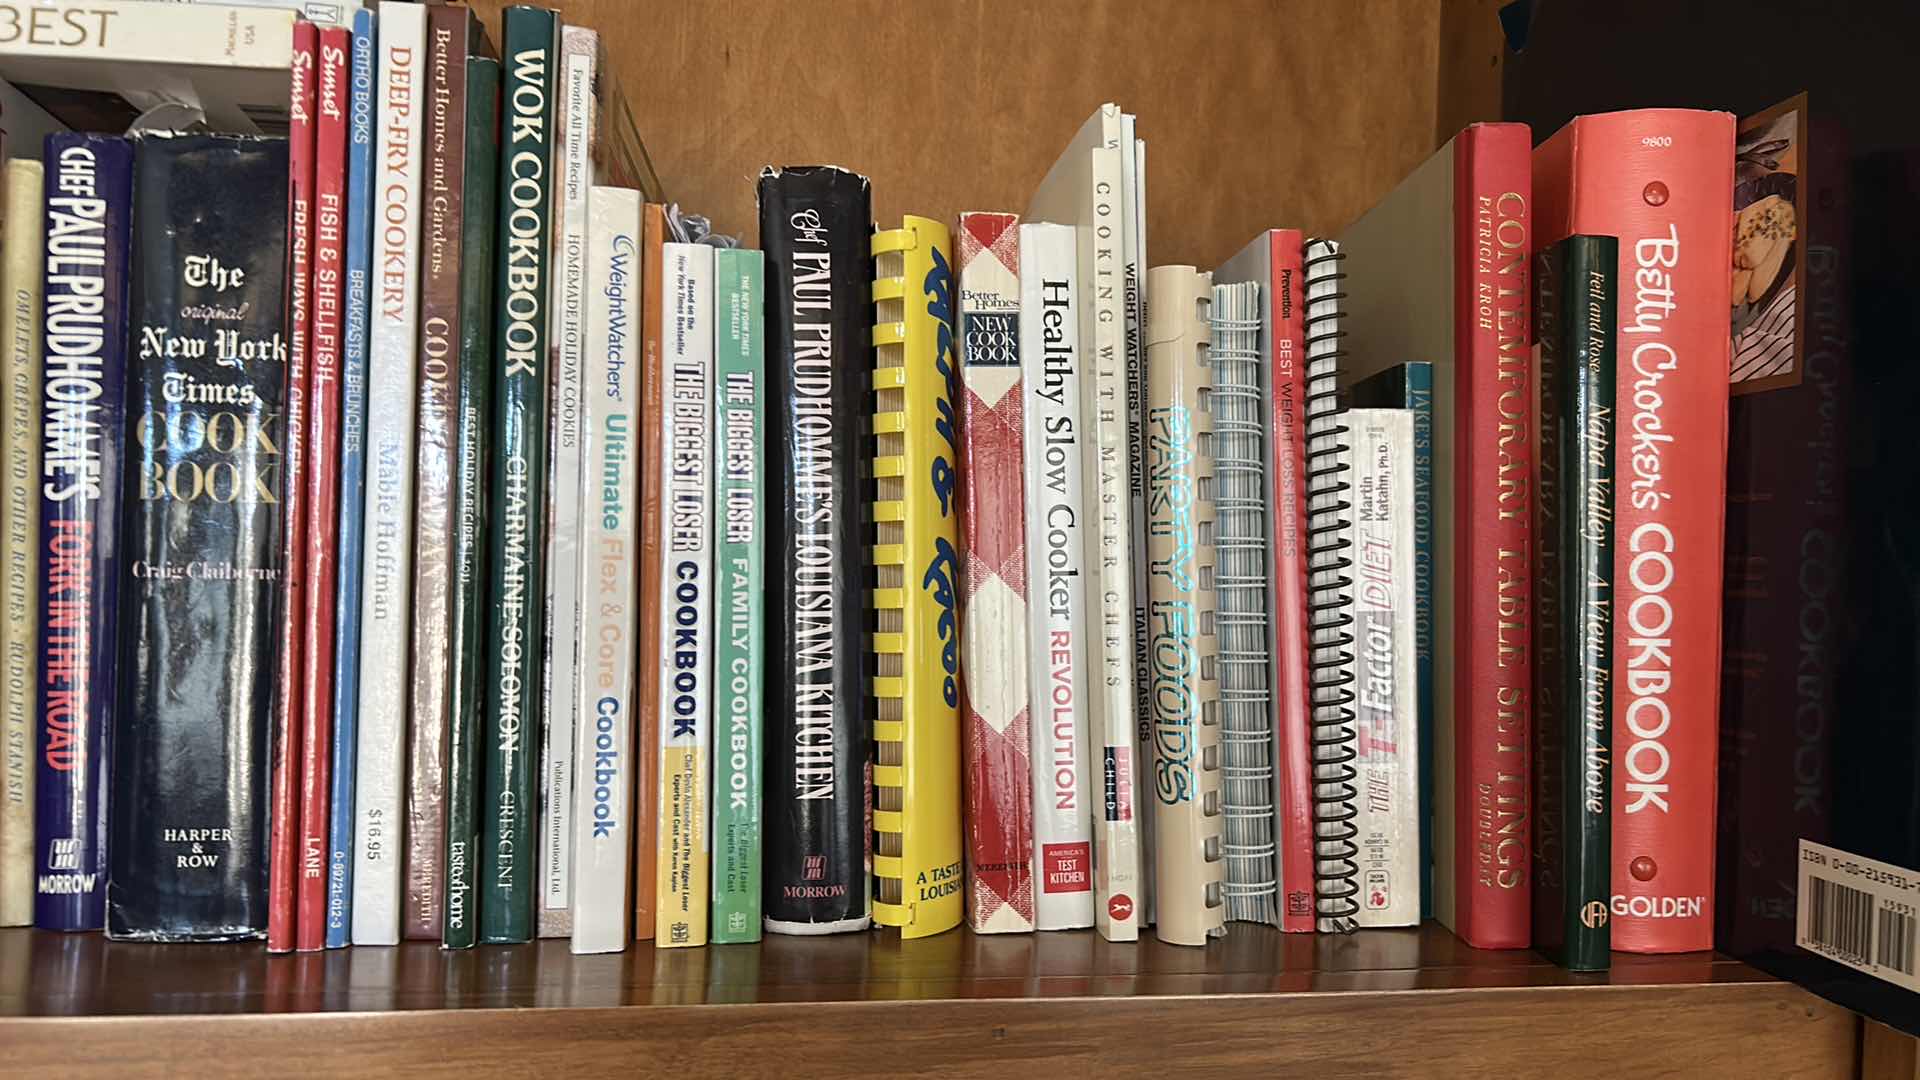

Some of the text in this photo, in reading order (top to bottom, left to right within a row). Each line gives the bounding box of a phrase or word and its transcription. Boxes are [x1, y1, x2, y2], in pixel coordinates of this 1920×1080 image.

[0, 6, 118, 47] BEST
[245, 25, 256, 45] USA
[291, 50, 312, 125] Sunset
[323, 45, 344, 121] Sunset
[354, 37, 370, 144] ORTHO BOOKS
[432, 29, 451, 191] Better Homes and
[566, 68, 584, 201] Favorite All Time Recipes
[1642, 136, 1672, 148] 9800
[382, 47, 412, 323] DEEP-FRY COOKERY
[505, 49, 545, 377] WOK COOKBOOK
[294, 199, 308, 265] FRESH
[1479, 196, 1493, 330] PATRICIA KROH
[184, 255, 245, 292] The
[316, 193, 339, 381] FISH & SHELLFISH
[687, 279, 696, 303] Based
[961, 290, 1000, 301] Better
[974, 298, 1020, 310] Homes
[44, 147, 107, 501] CHEF PAUL PRUDHOMME'S
[180, 301, 250, 325] original
[562, 234, 581, 448] HOMEMADE HOLIDAY COOKIES
[675, 291, 685, 355] Times Bestseller
[730, 293, 739, 340] BESTSELLER
[966, 331, 1017, 347] COOK
[972, 316, 1013, 331] NEW
[139, 326, 287, 368] New York
[344, 269, 364, 453] BREAKFASTS BRUNCHES
[966, 346, 1017, 361] BOOK
[1125, 263, 1142, 498] WEIGHT MAGAZINE
[1279, 269, 1297, 558] Prevention BEST WEIGHT LOSS RECIPES
[136, 411, 281, 454] COOK
[1096, 182, 1121, 687] COOKING WITH MASTER CHEFS
[138, 460, 280, 503] BOOK
[462, 407, 477, 547] BEST HOLIDAY RECIPES
[790, 208, 834, 801] Chef PAUL PRUDHOMME'S LOUISIANA KITCHEN
[931, 455, 957, 518] &
[1359, 476, 1374, 522] Martin
[1376, 441, 1391, 522] Katahn, Ph.D.
[7, 288, 32, 803] OMELETS, AND OTHER RECIPES RUDOLPH STANISH
[374, 442, 399, 620] Mable Hoffman
[671, 362, 705, 738] THE BIGGEST LOSER COOKBOOK
[1035, 278, 1079, 810] Healthy Slow Cooker REVOLUTION
[1411, 389, 1431, 659] JAKE'S SEAFOOD COOKBOOK
[1496, 191, 1528, 889] CONTEMPORARY TABLE SETTINGS
[1580, 271, 1613, 814] Feil and Rose Napa Valley A View From Above
[1623, 223, 1680, 814] Betty Crocker's COOKBOOK
[132, 560, 282, 581] Craig Claiborne
[725, 371, 754, 809] THE BIGGEST LOSER FAMILY COOKBOOK
[1356, 528, 1393, 611] DIET
[499, 454, 528, 752] CHARMAINE SOLOMON
[593, 414, 628, 838] Ultimate Flex & Core Cookbook
[1150, 407, 1198, 806] PARTY FOODS
[46, 519, 95, 771] FORK IN THE ROAD
[1135, 606, 1151, 743] ITALIAN CLASSICS
[1105, 756, 1116, 811] CHILD
[1118, 756, 1128, 811] JULIA
[1368, 768, 1391, 815] THE
[164, 828, 234, 842] HARPER
[191, 843, 204, 854] &
[367, 808, 382, 861] $16.95
[496, 790, 516, 889] CRESCENT
[552, 760, 564, 876] Publications International,
[38, 874, 97, 894] MORROW
[176, 855, 219, 868] ROW
[305, 837, 321, 879] LANE
[916, 861, 961, 885] A TASTE
[1049, 849, 1085, 857] AMERICA'S
[1050, 871, 1085, 885] KITCHEN
[1057, 860, 1078, 872] TEST
[1803, 848, 1827, 866] ISBN
[783, 885, 848, 898] MORROW
[1610, 894, 1701, 918] GOLDEN
